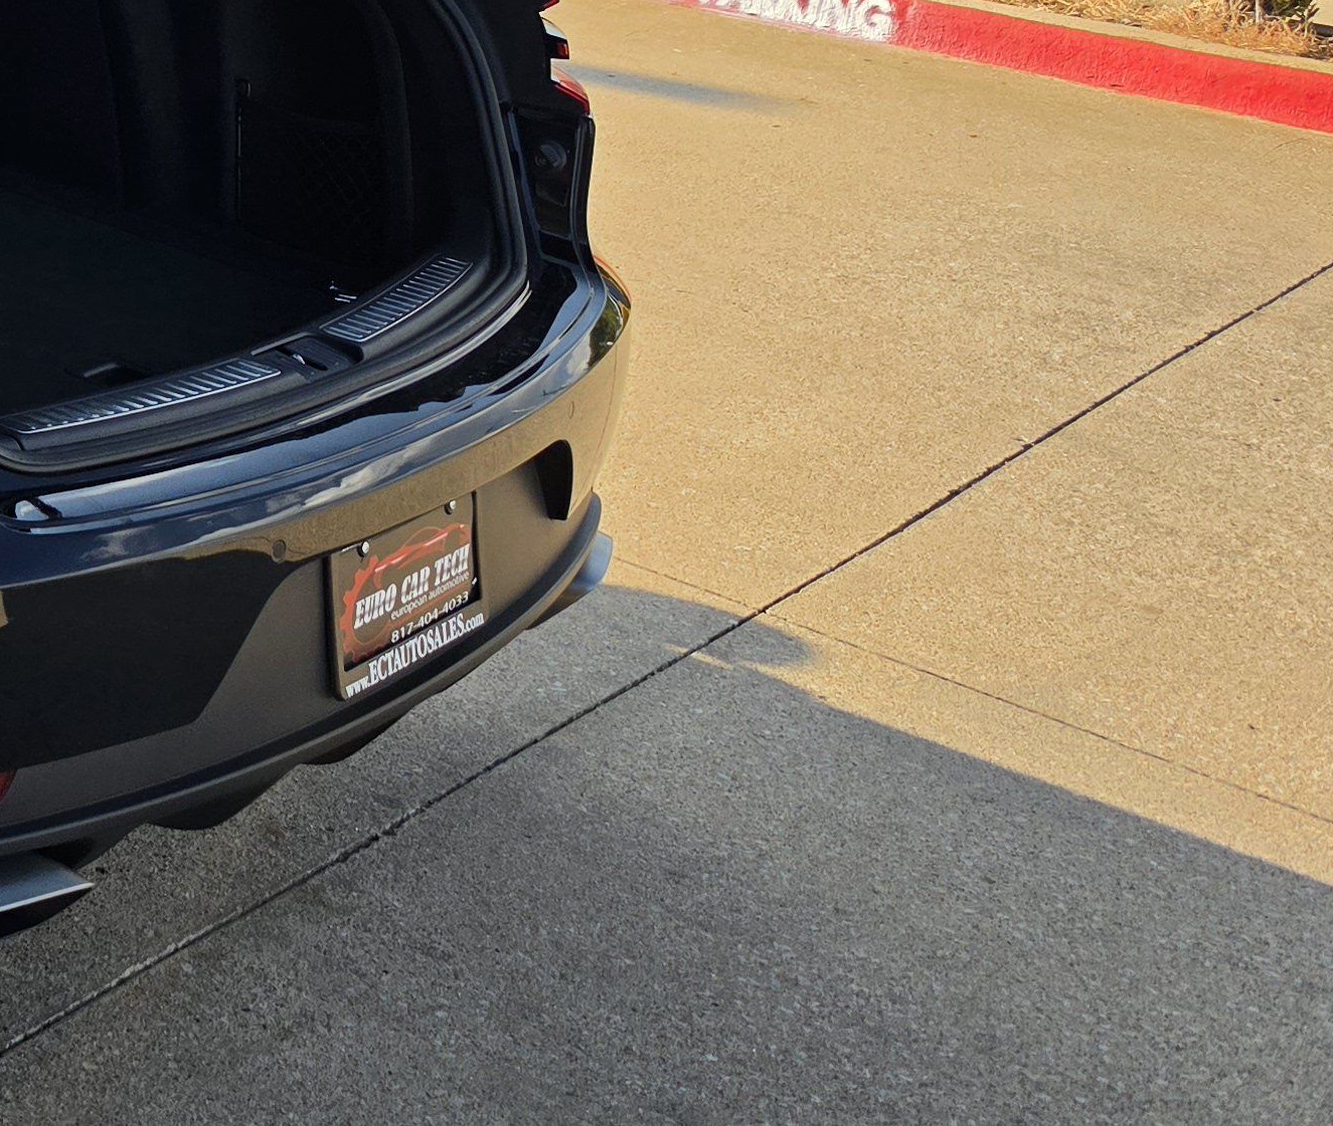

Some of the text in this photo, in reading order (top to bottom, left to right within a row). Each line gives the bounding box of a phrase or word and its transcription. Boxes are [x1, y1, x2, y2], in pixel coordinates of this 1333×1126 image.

[353, 543, 470, 630] EURO CAR TECH
[390, 571, 470, 620] european automotive
[391, 591, 469, 643] 817-404-4033
[345, 612, 485, 698] www.ECTAUTOSALES.com
